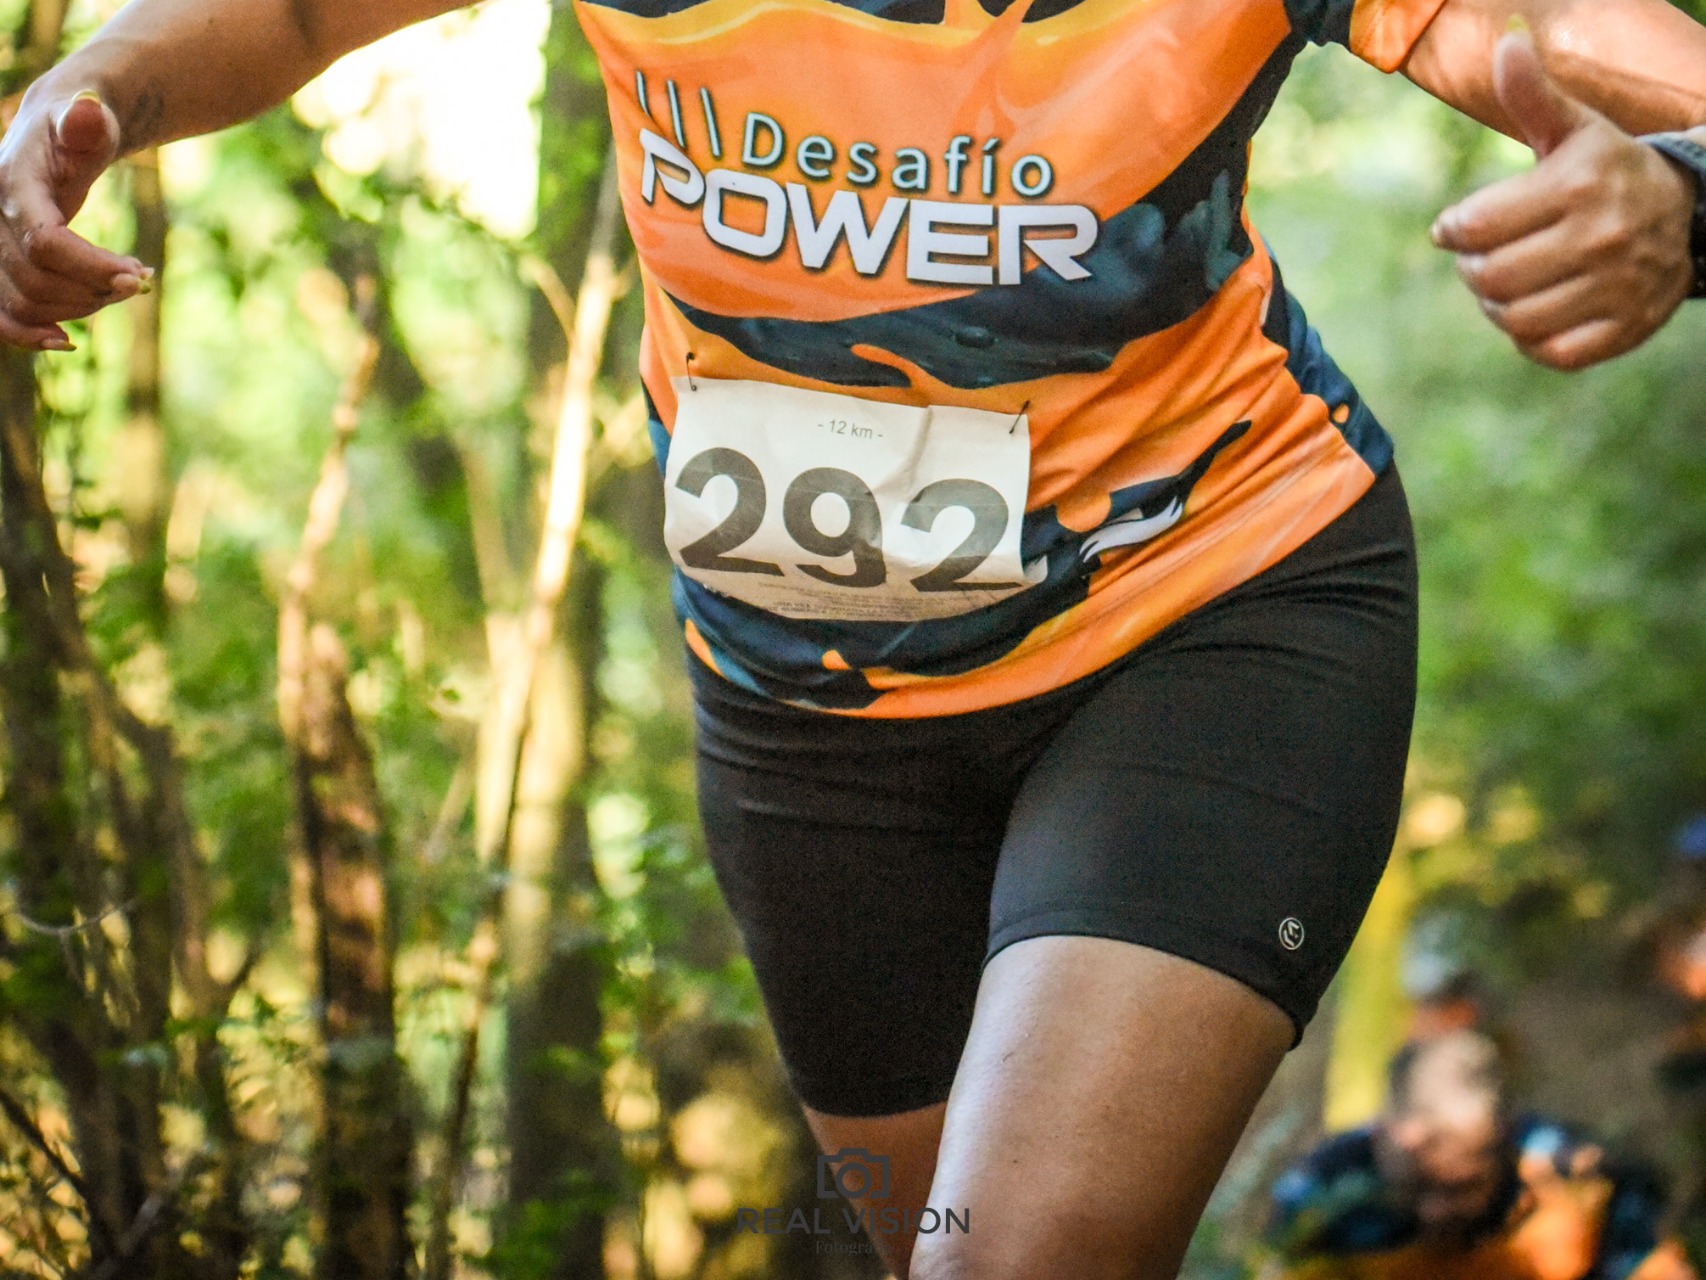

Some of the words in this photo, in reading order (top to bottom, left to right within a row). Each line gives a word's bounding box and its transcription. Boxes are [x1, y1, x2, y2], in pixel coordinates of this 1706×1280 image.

[638, 127, 1100, 286] POWER
[742, 111, 1054, 197] Desafío
[829, 419, 848, 435] 12
[850, 422, 873, 440] km
[675, 446, 1024, 593] 292
